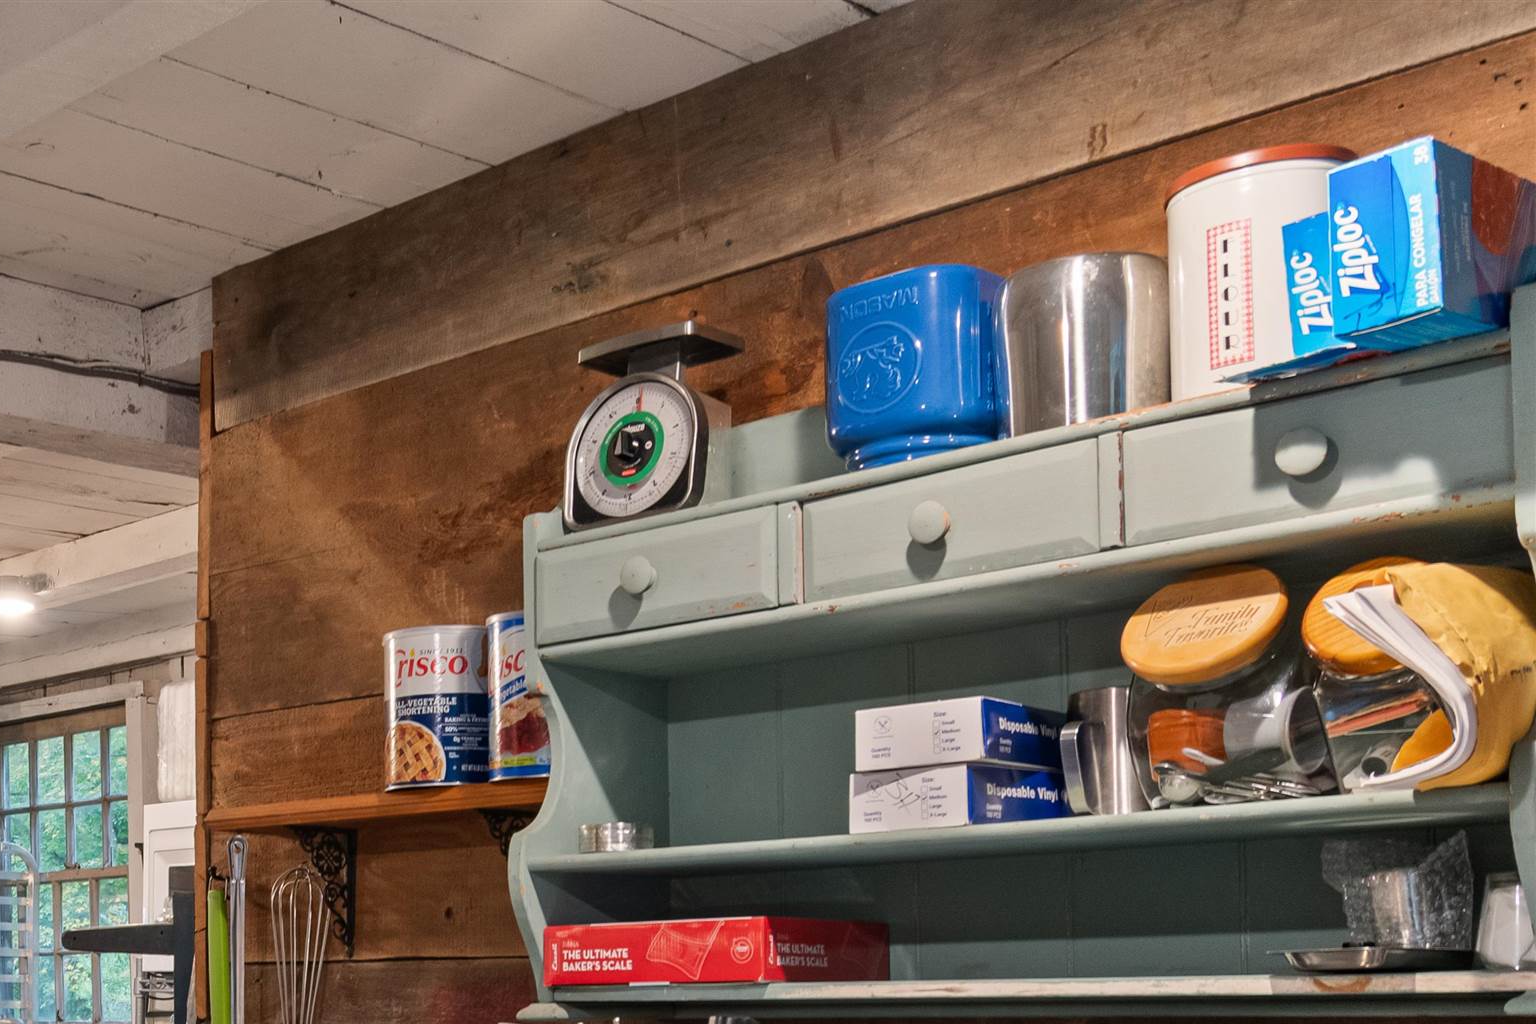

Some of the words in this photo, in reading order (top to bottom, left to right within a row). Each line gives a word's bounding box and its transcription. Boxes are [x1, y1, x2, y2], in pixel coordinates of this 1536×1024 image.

[1409, 193, 1427, 268] CONGELAR
[1333, 206, 1381, 297] Ziploc
[1222, 238, 1241, 351] FLOUR
[1290, 252, 1334, 336] Ziploc
[1415, 270, 1428, 308] PARA
[1191, 602, 1262, 630] Family
[397, 705, 450, 718] SHORTENING
[998, 717, 1039, 736] Disposable
[986, 782, 1036, 800] Disposable
[1037, 786, 1059, 804] Vinyl
[562, 949, 581, 960] THE
[582, 947, 629, 959] ULTIMATE
[776, 943, 791, 954] THE
[791, 944, 826, 955] ULTIMATE
[562, 961, 601, 972] BAKER'S
[601, 960, 633, 971] SCALE
[776, 956, 806, 967] BAKER'S
[806, 956, 829, 968] SCALE
